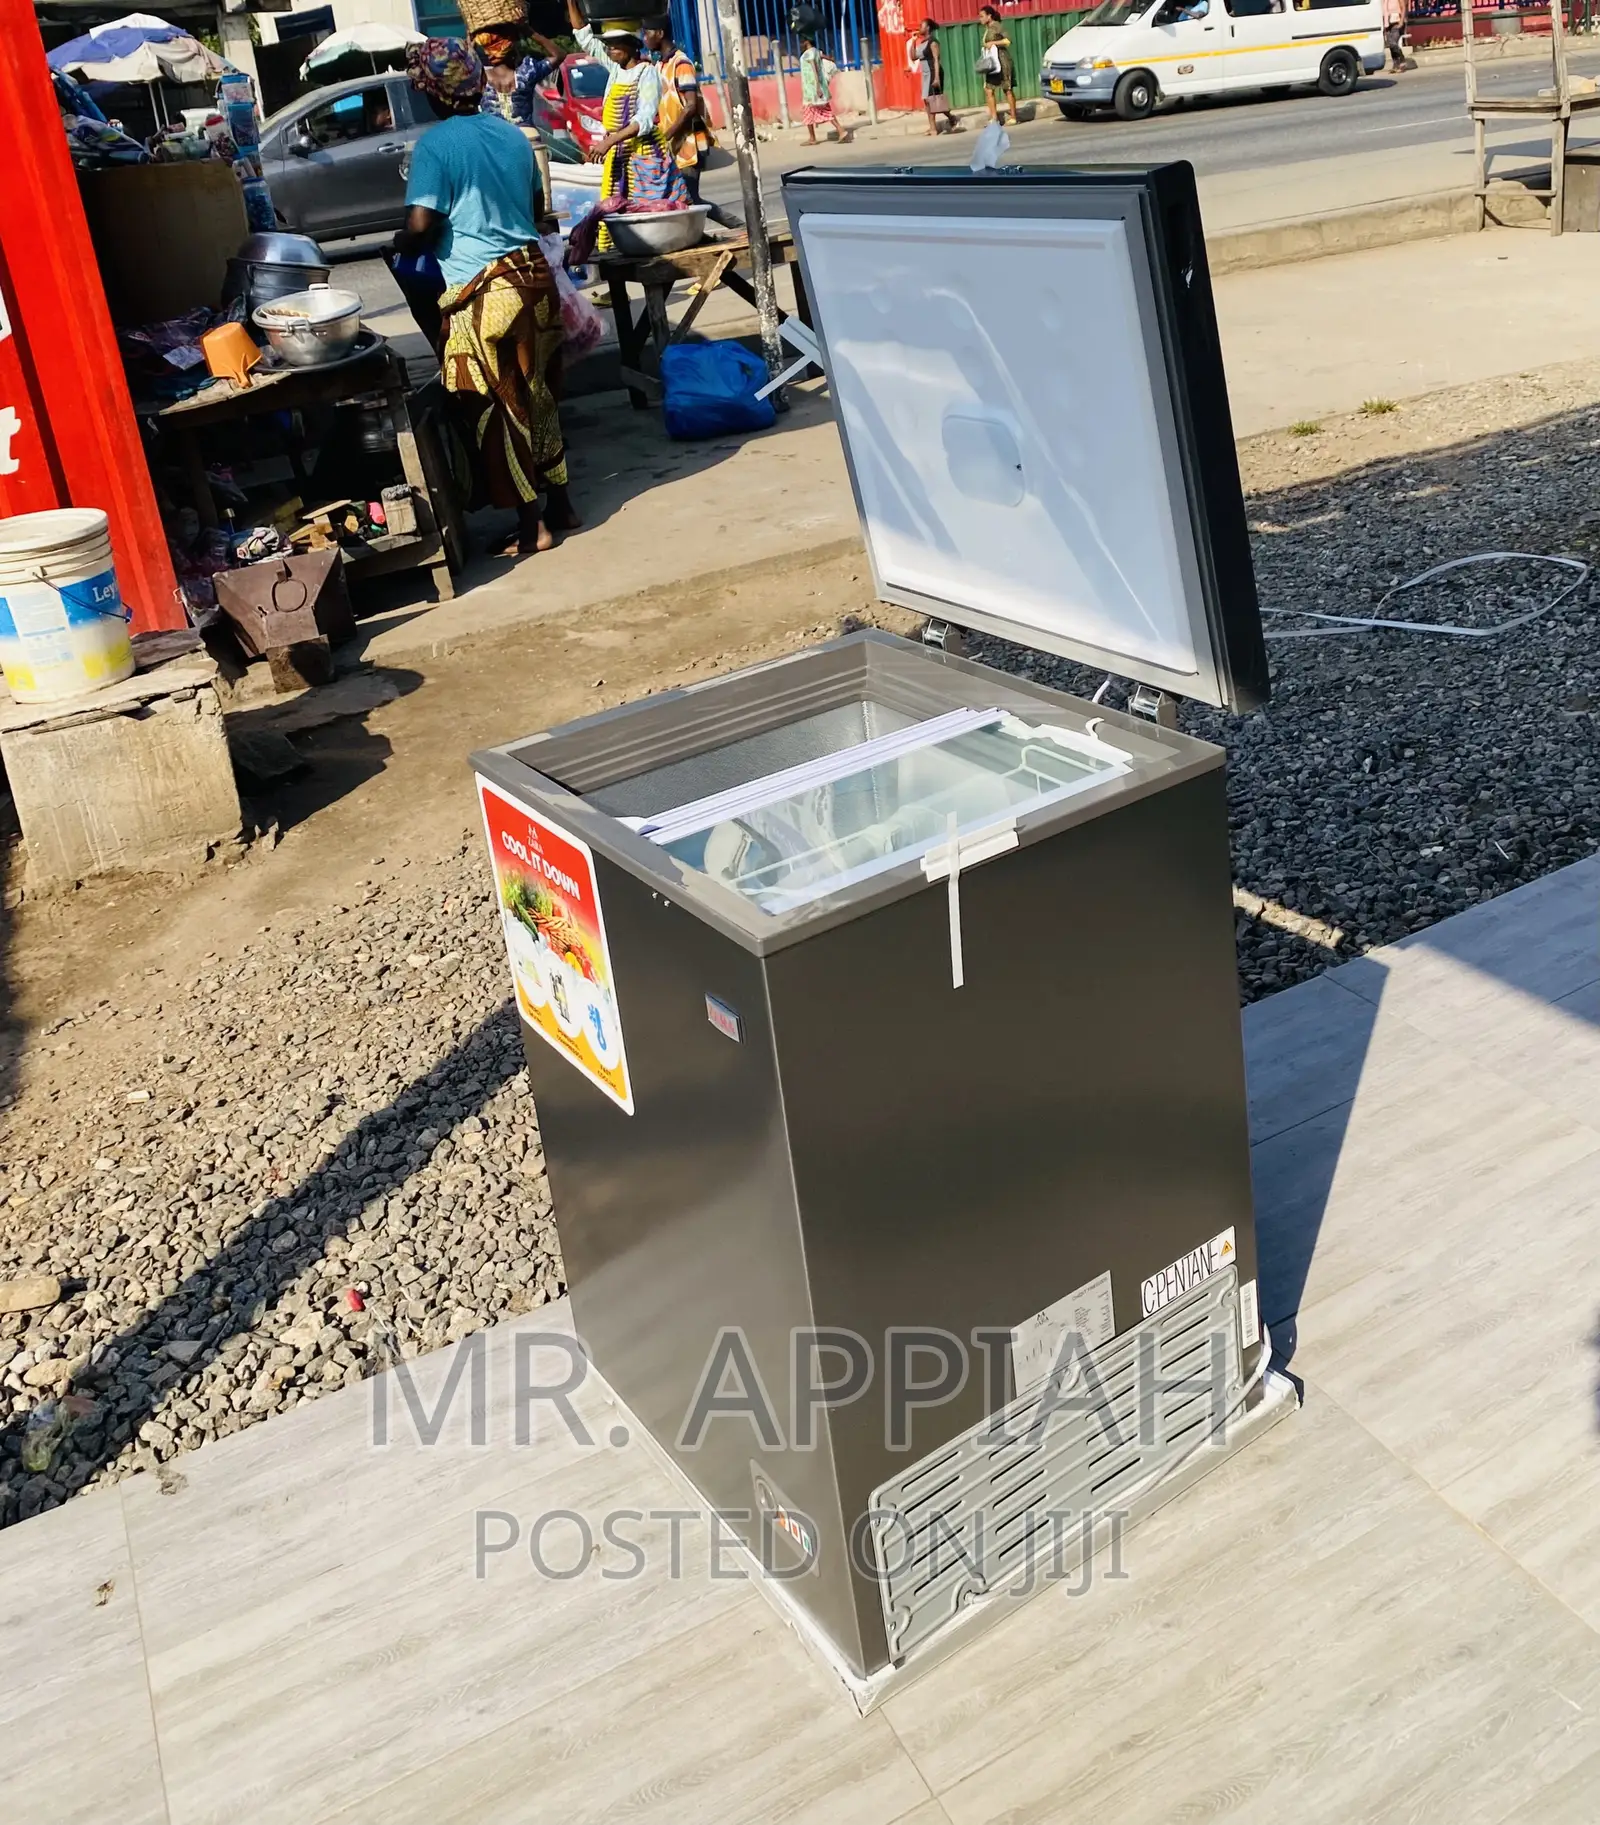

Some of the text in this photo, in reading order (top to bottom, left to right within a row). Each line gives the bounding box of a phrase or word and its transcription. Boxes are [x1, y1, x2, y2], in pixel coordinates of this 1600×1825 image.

[92, 575, 117, 602] Ley
[501, 830, 581, 901] COOL IT DOWN
[1143, 1238, 1220, 1314] C-PENTANE
